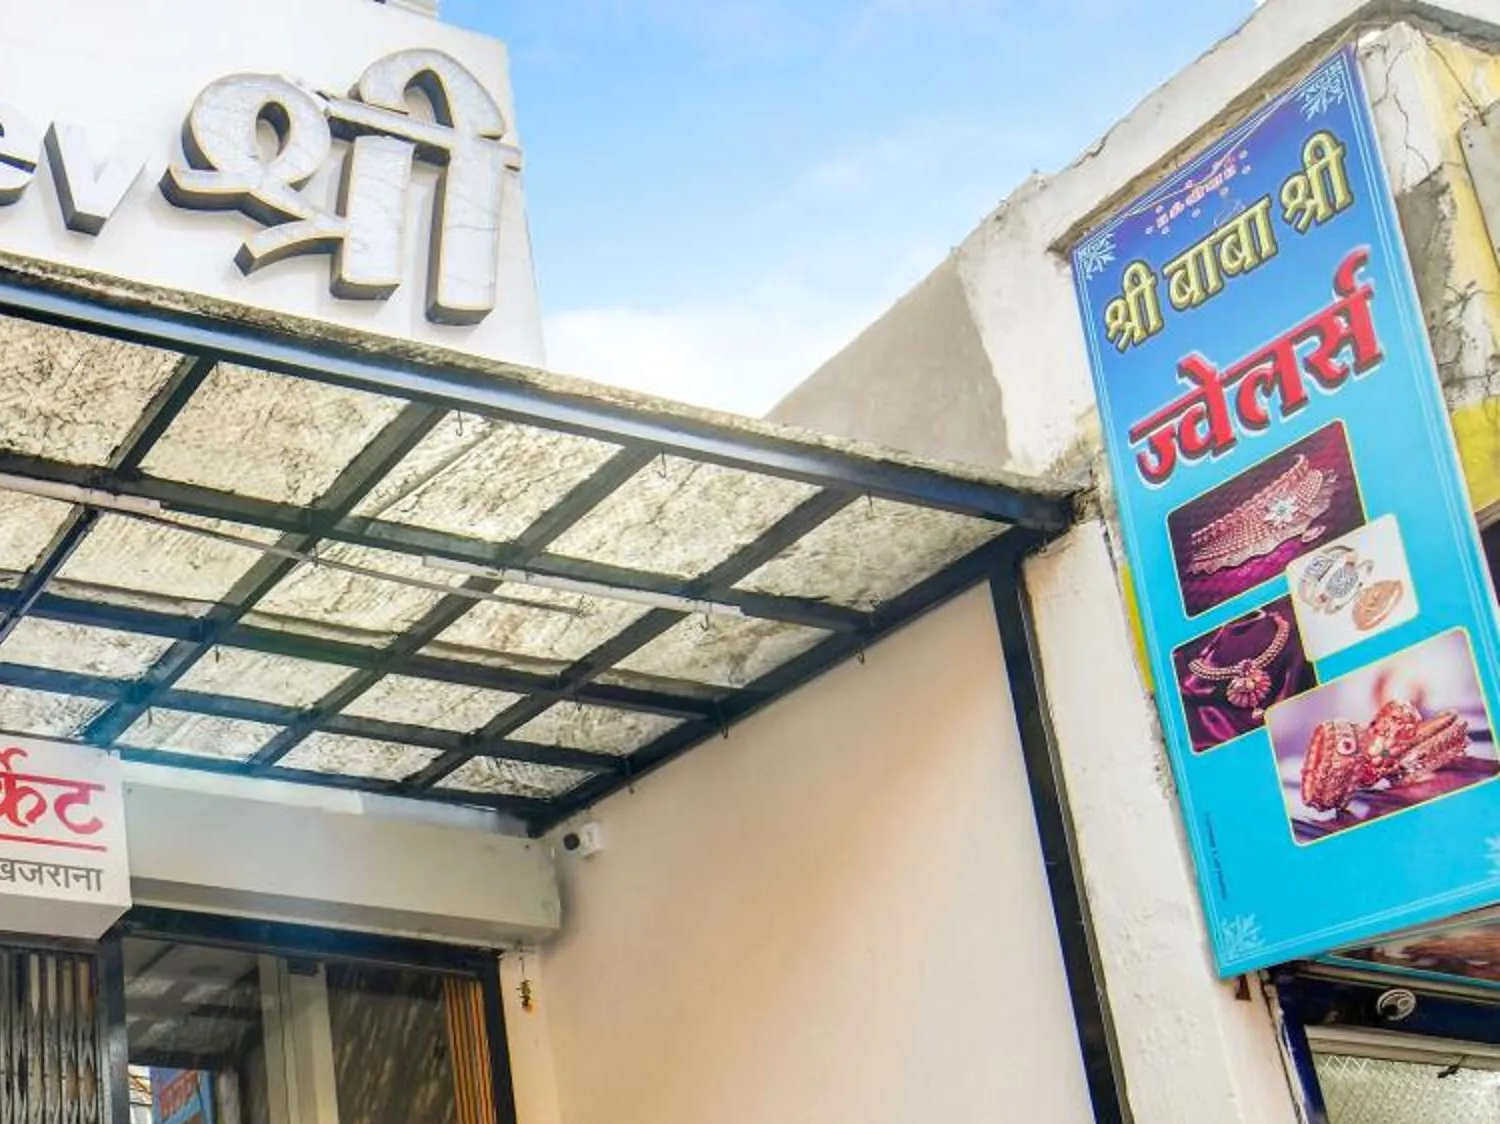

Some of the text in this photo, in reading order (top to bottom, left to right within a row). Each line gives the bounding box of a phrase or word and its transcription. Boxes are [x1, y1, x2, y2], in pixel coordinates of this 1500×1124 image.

[1104, 262, 1164, 354] श्री
[1162, 197, 1279, 313] बाबा
[1280, 130, 1354, 235] श्री
[1128, 246, 1384, 487] ज्वेलर्स
